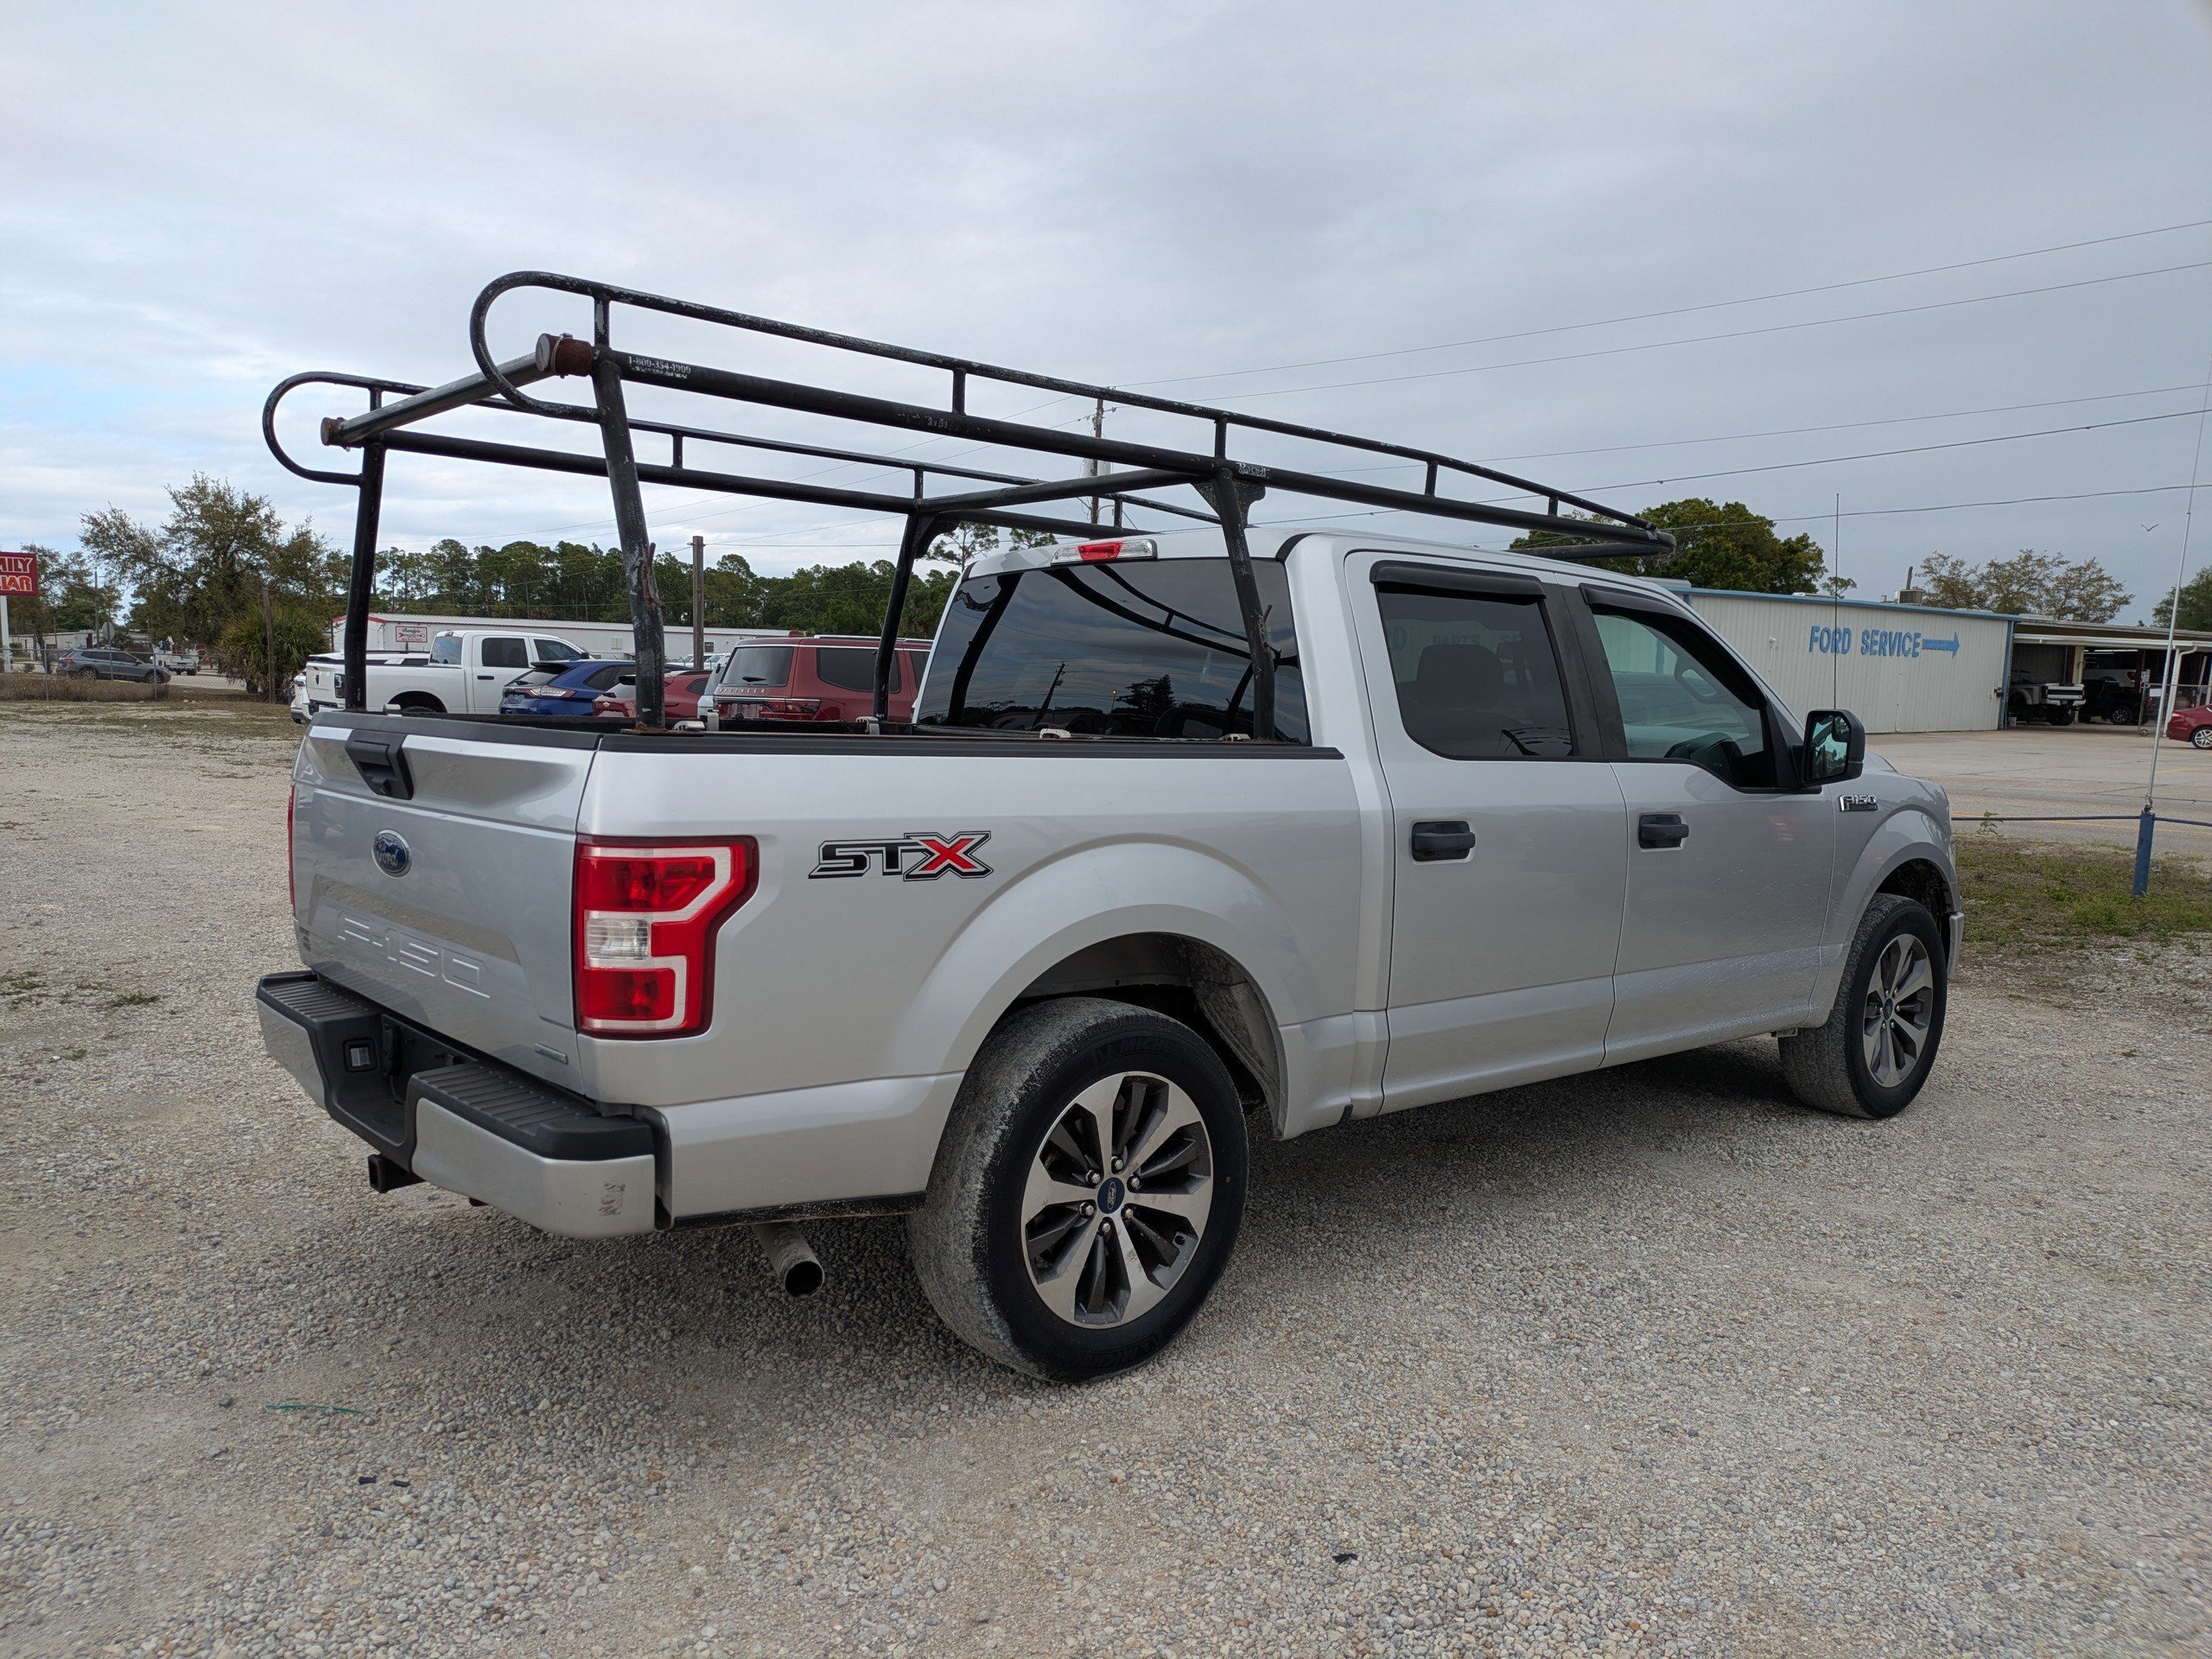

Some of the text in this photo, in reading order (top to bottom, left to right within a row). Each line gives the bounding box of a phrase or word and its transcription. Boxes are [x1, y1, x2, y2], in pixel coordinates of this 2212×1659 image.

[1808, 626, 1922, 658] FORD SERVICE
[808, 830, 995, 882] STX
[336, 909, 491, 999] F-150
